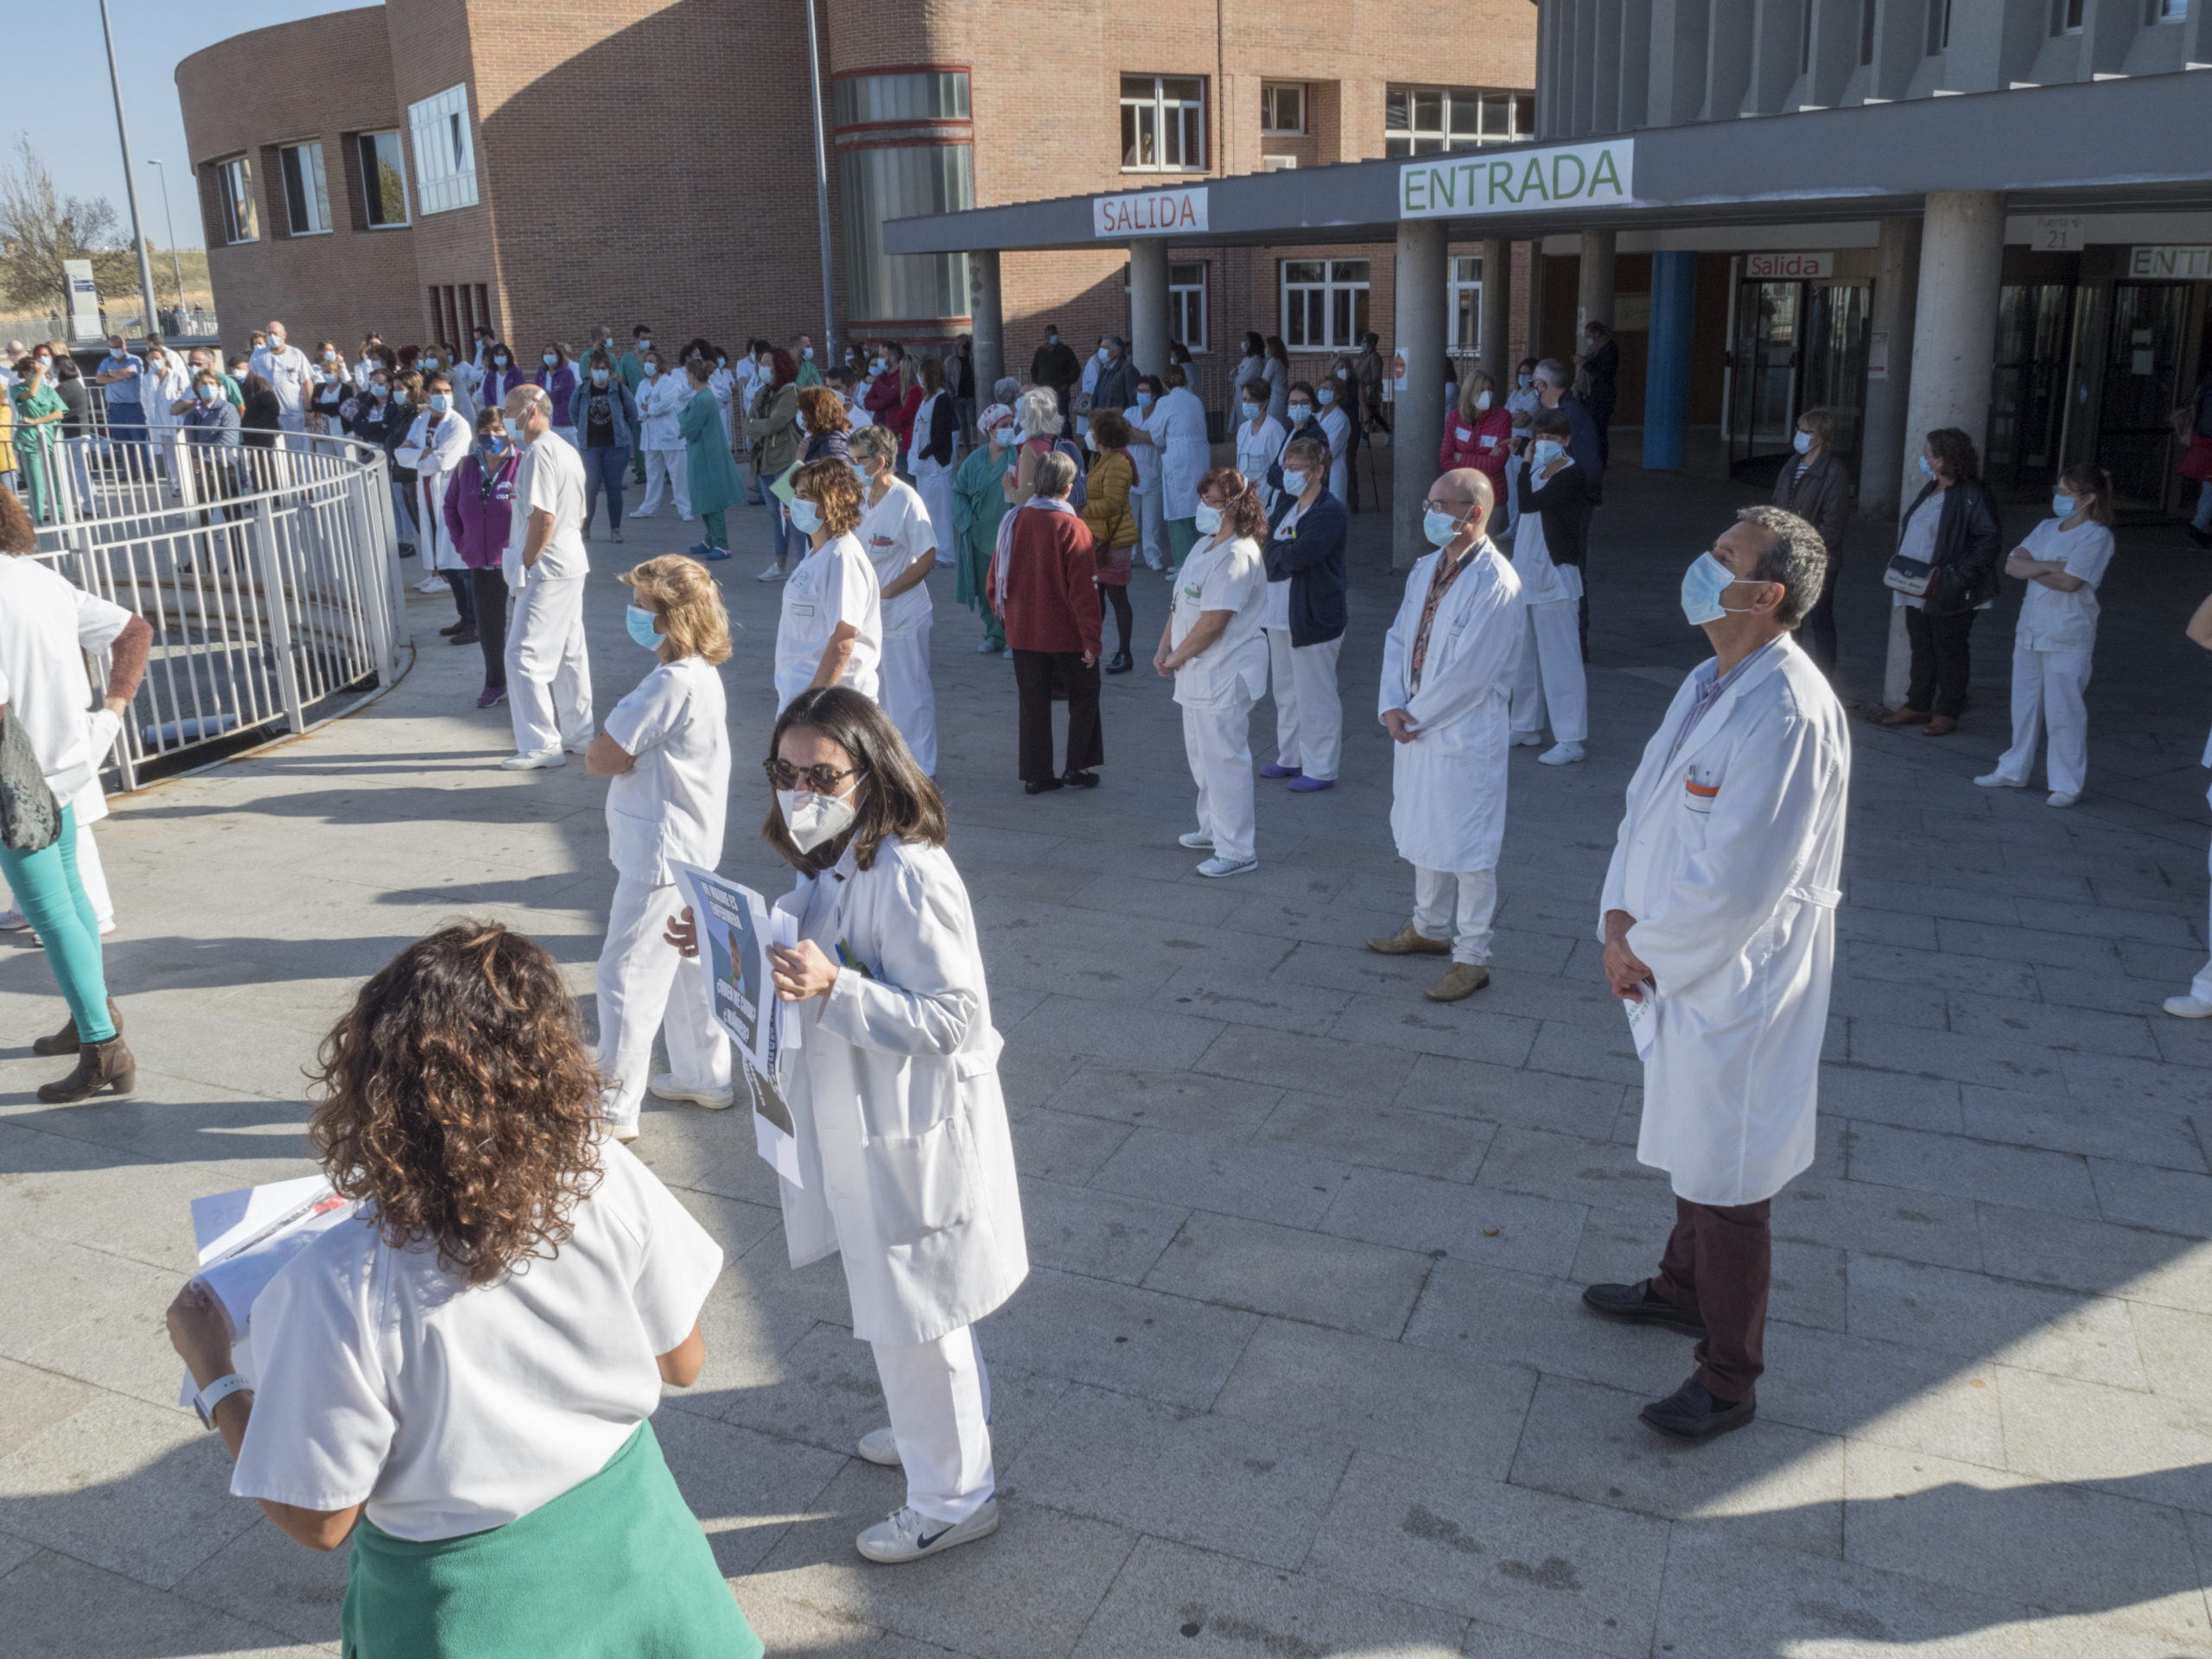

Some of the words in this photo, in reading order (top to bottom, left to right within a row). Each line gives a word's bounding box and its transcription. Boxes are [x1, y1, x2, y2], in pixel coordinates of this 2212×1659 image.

[1404, 149, 1624, 212] ENTRADA
[1102, 194, 1197, 232] SALIDA
[2047, 230, 2068, 249] 21
[1751, 255, 1820, 276] Salida
[2133, 250, 2212, 274] ENT
